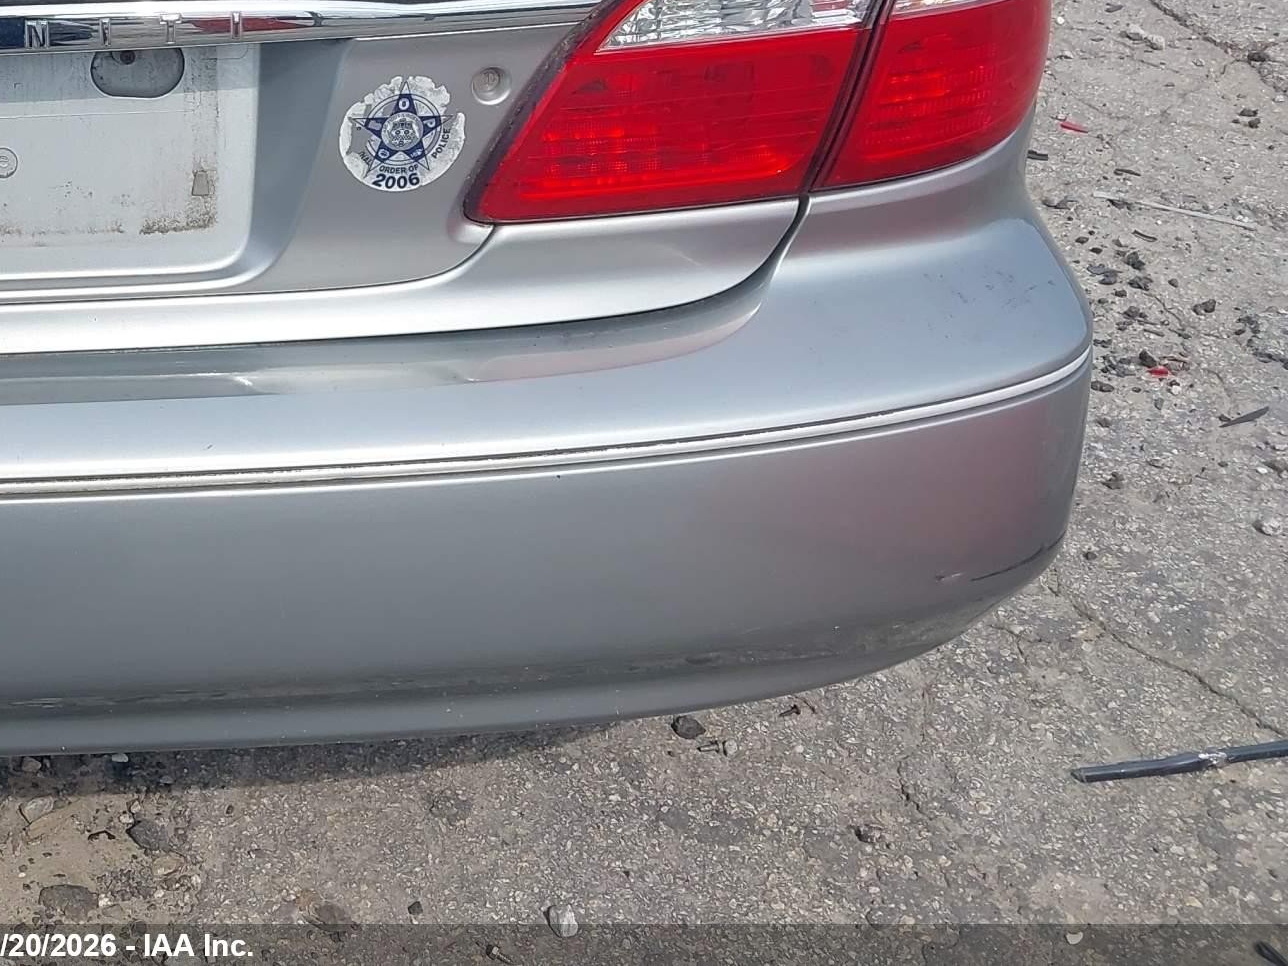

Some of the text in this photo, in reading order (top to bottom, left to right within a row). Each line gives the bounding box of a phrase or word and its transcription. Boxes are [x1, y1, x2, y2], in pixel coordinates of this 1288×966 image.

[379, 164, 407, 175] ORDER
[431, 128, 452, 159] POLICE
[372, 172, 420, 189] 2006
